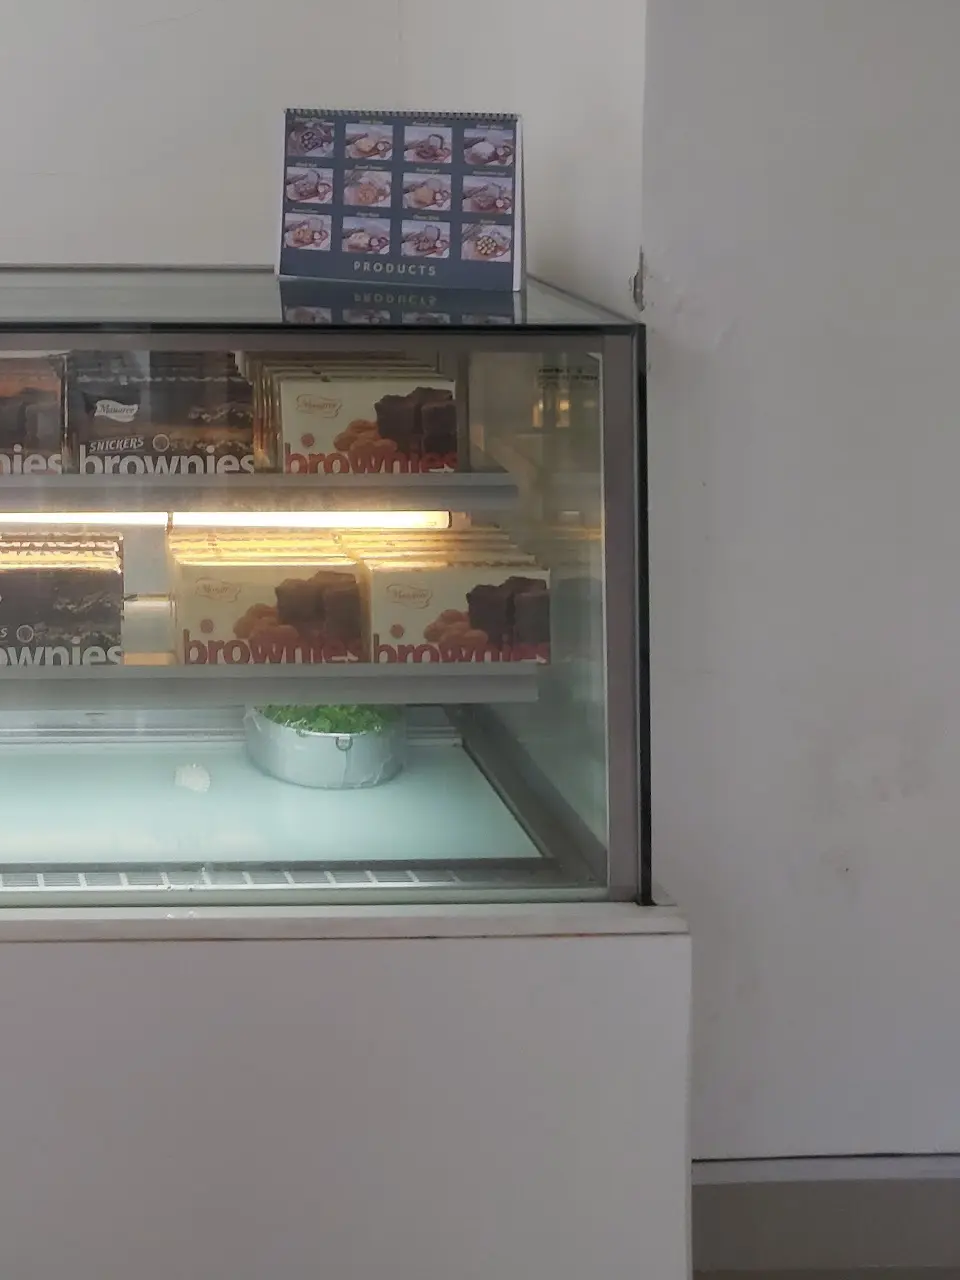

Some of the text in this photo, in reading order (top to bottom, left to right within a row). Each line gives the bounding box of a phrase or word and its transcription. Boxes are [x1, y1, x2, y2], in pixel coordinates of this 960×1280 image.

[353, 260, 437, 276] PRODUCTS
[88, 437, 144, 453] SNICKERS
[80, 444, 255, 475] brownies
[285, 442, 458, 474] brownies
